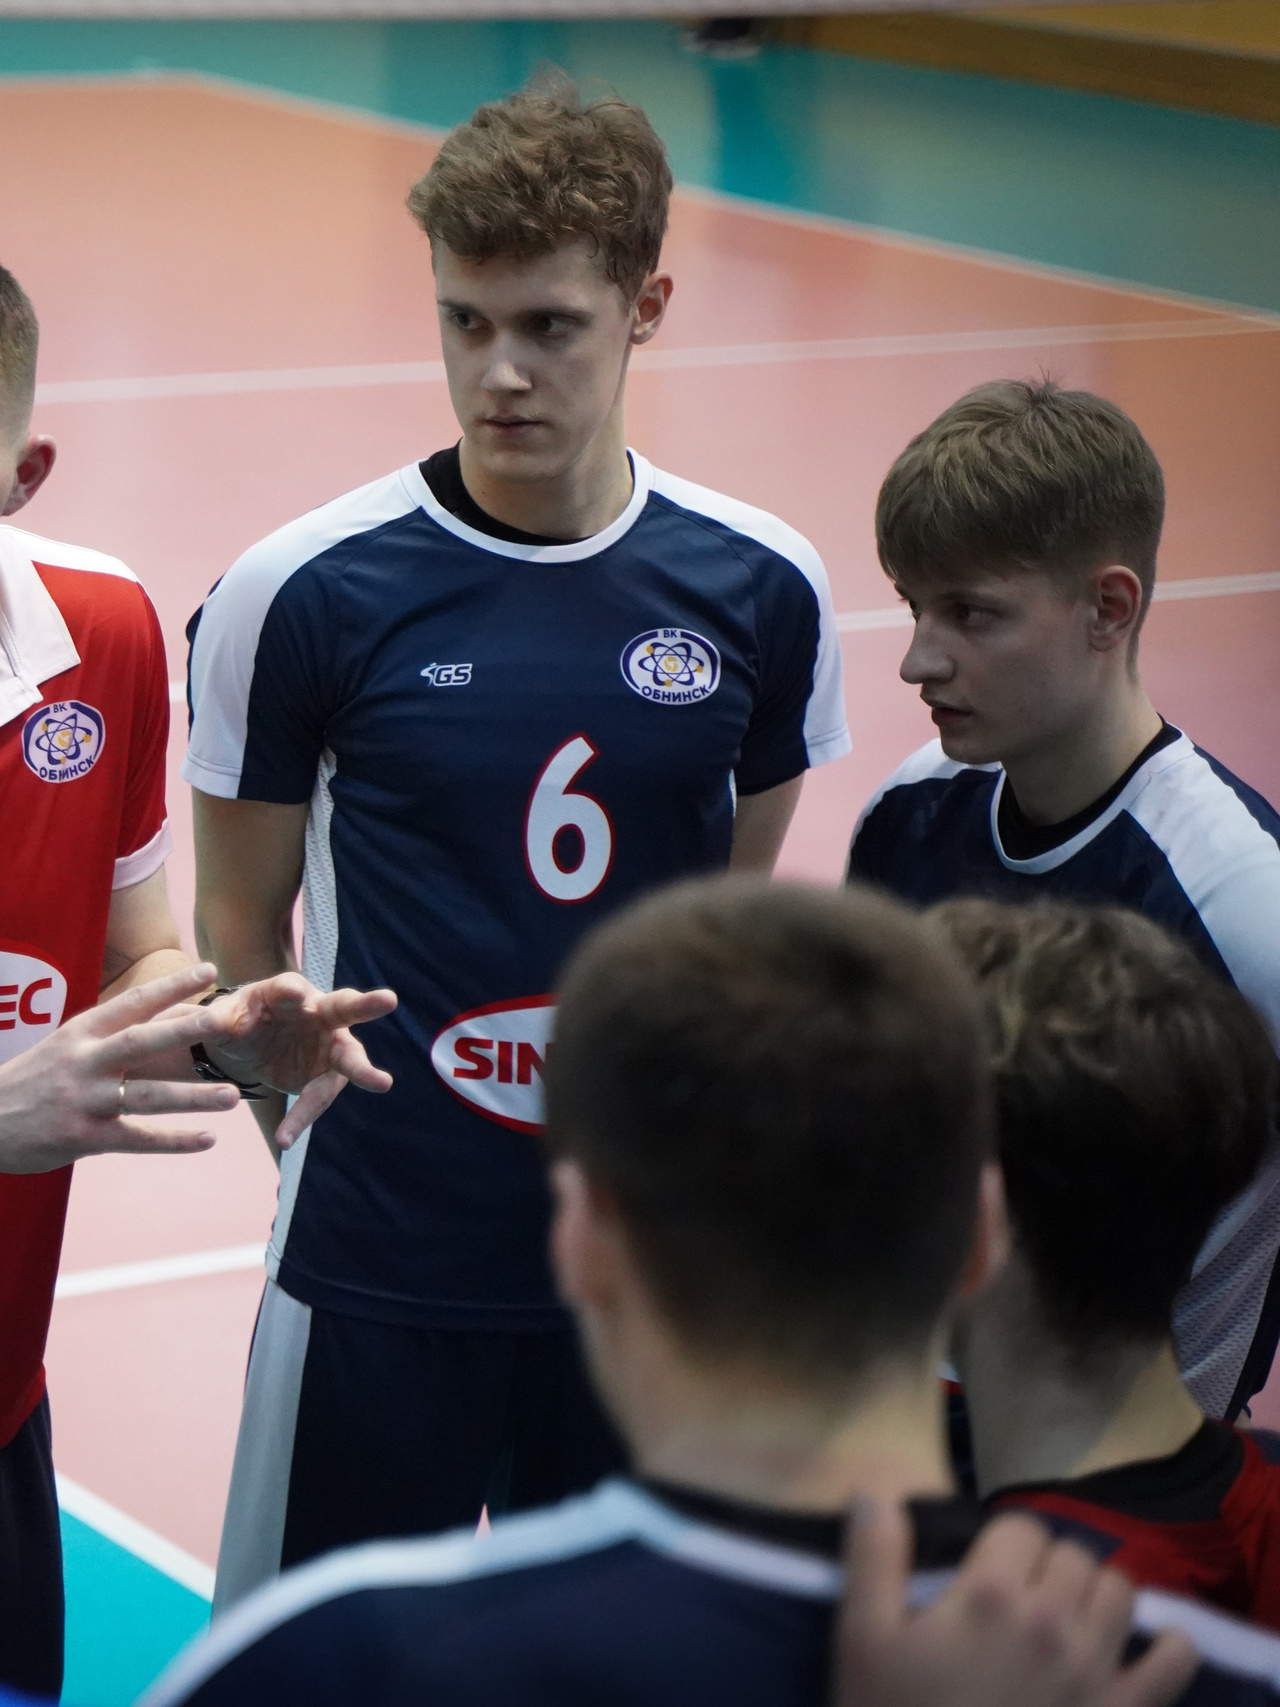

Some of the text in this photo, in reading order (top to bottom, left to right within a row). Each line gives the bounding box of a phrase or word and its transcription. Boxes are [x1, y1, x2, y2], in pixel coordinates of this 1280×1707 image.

[662, 629, 678, 639] ВК
[432, 663, 473, 687] GS
[641, 685, 710, 703] ОБНИНСК
[53, 702, 68, 714] ВК
[524, 732, 615, 904] 6
[453, 1036, 552, 1086] SIN
